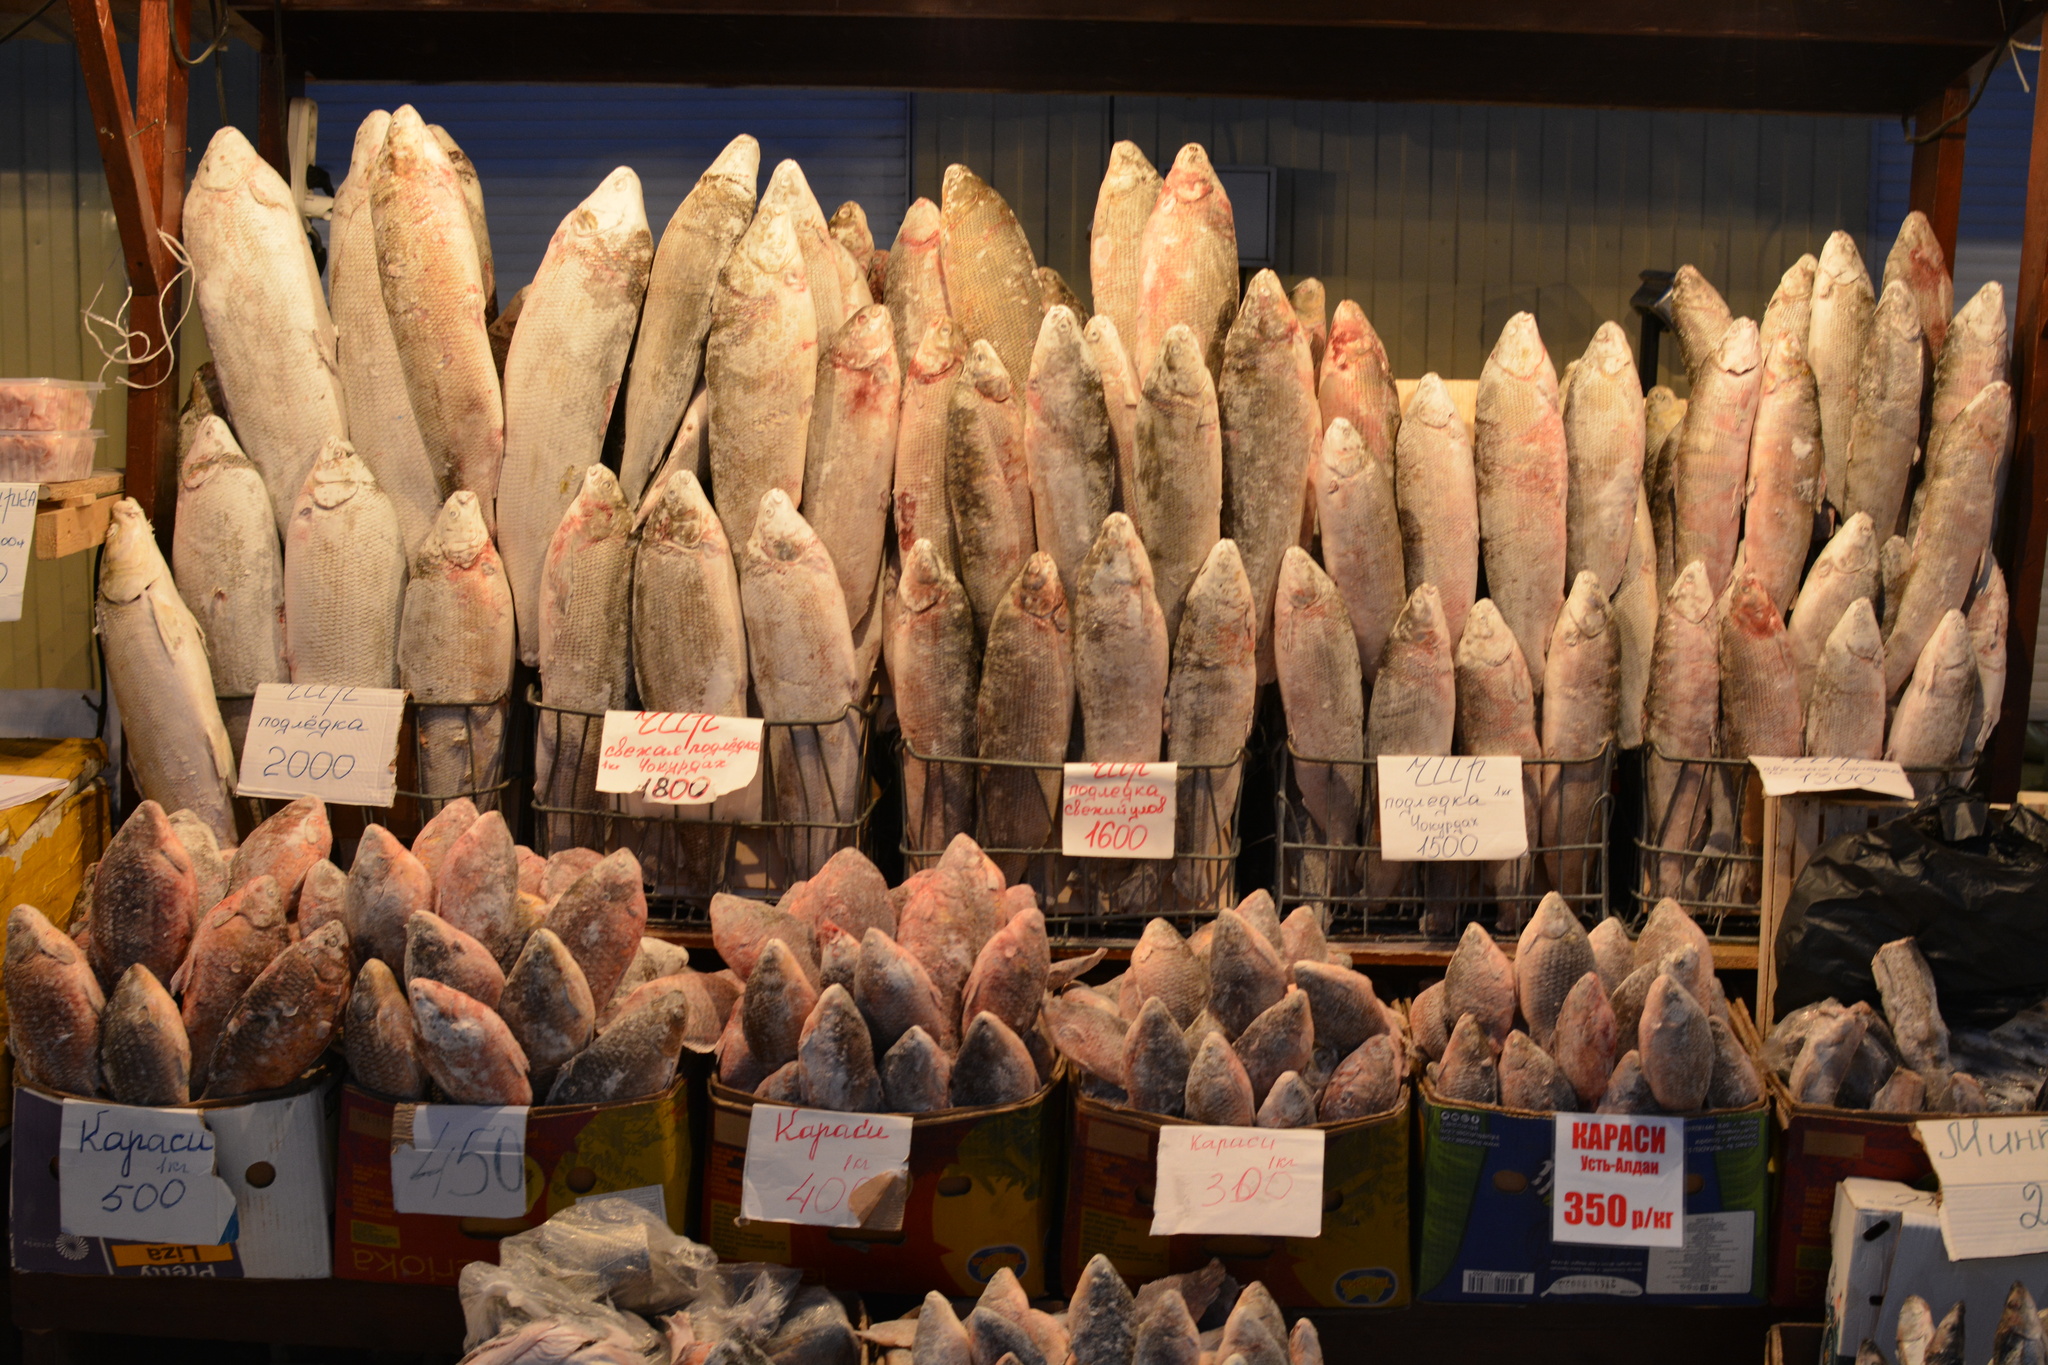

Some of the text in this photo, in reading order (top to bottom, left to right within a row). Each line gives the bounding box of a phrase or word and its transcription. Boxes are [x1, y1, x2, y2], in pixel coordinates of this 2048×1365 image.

[258, 715, 368, 738] подлёдка
[264, 746, 356, 780] 2000
[639, 758, 728, 777] Чокурдах
[638, 776, 711, 800] 1800
[1069, 784, 1161, 803] подледка
[1064, 795, 1167, 822] свежий улов
[1384, 794, 1487, 818] подледка
[1084, 821, 1148, 851] 1600
[1416, 834, 1479, 860] 1500
[80, 1109, 214, 1178] Караси
[775, 1108, 890, 1160] Караси
[1190, 1134, 1276, 1157] Караси
[1572, 1122, 1666, 1154] КАРАСИ
[410, 1121, 523, 1198] 450
[1268, 1155, 1297, 1169] 1кг
[1581, 1155, 1659, 1176] Усть-Алдан
[101, 1178, 186, 1212] 500
[1201, 1166, 1294, 1207] 300
[1563, 1191, 1674, 1230] 350 р/кг
[147, 1245, 201, 1262] Liza
